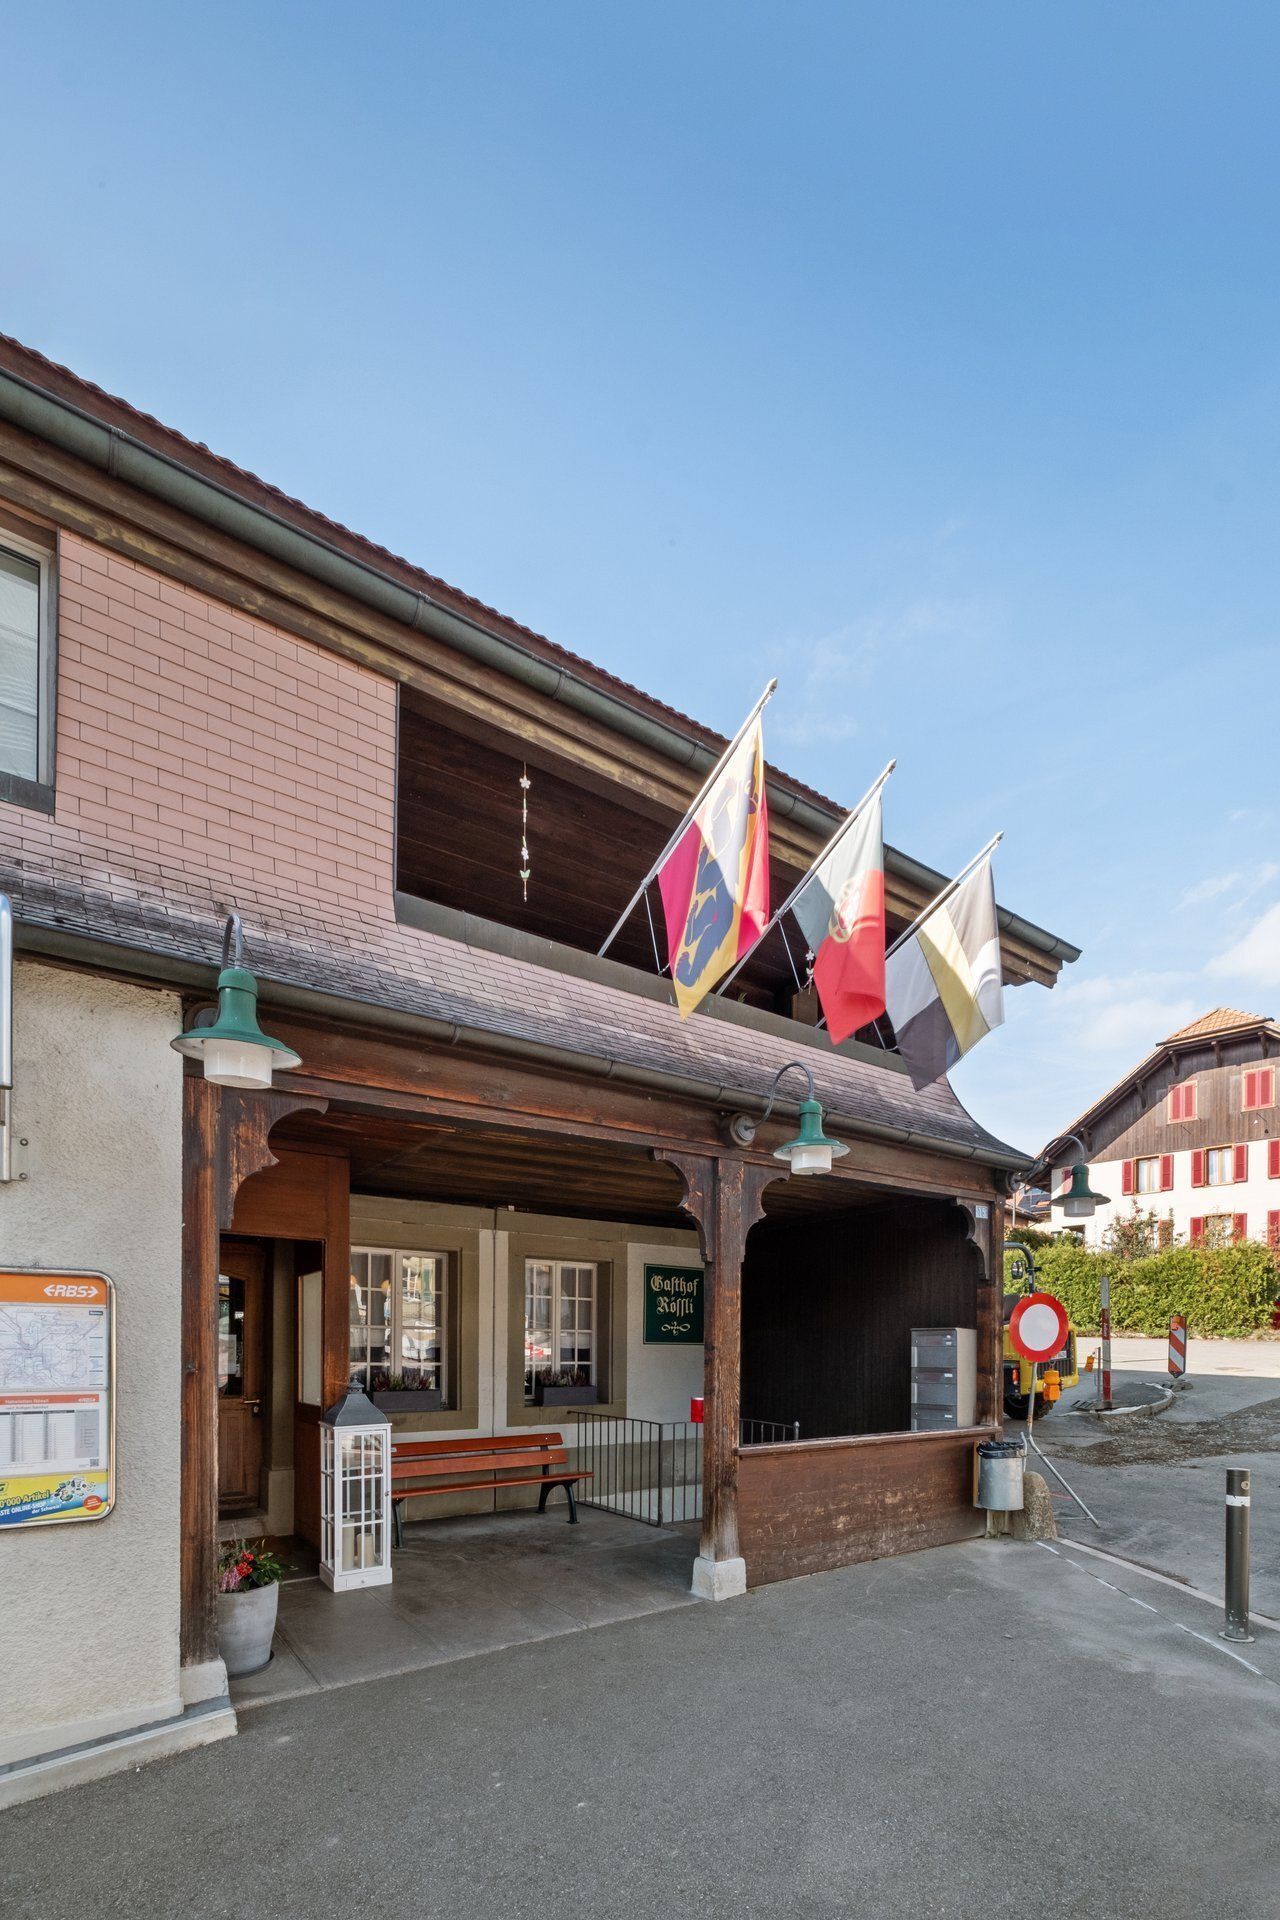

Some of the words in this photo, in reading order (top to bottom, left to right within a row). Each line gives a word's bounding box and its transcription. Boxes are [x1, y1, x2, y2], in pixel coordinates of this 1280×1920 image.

[55, 1285, 88, 1298] RBS
[650, 1274, 699, 1296] Gasthof
[656, 1297, 693, 1317] Rössli
[22, 1489, 50, 1503] Artikel
